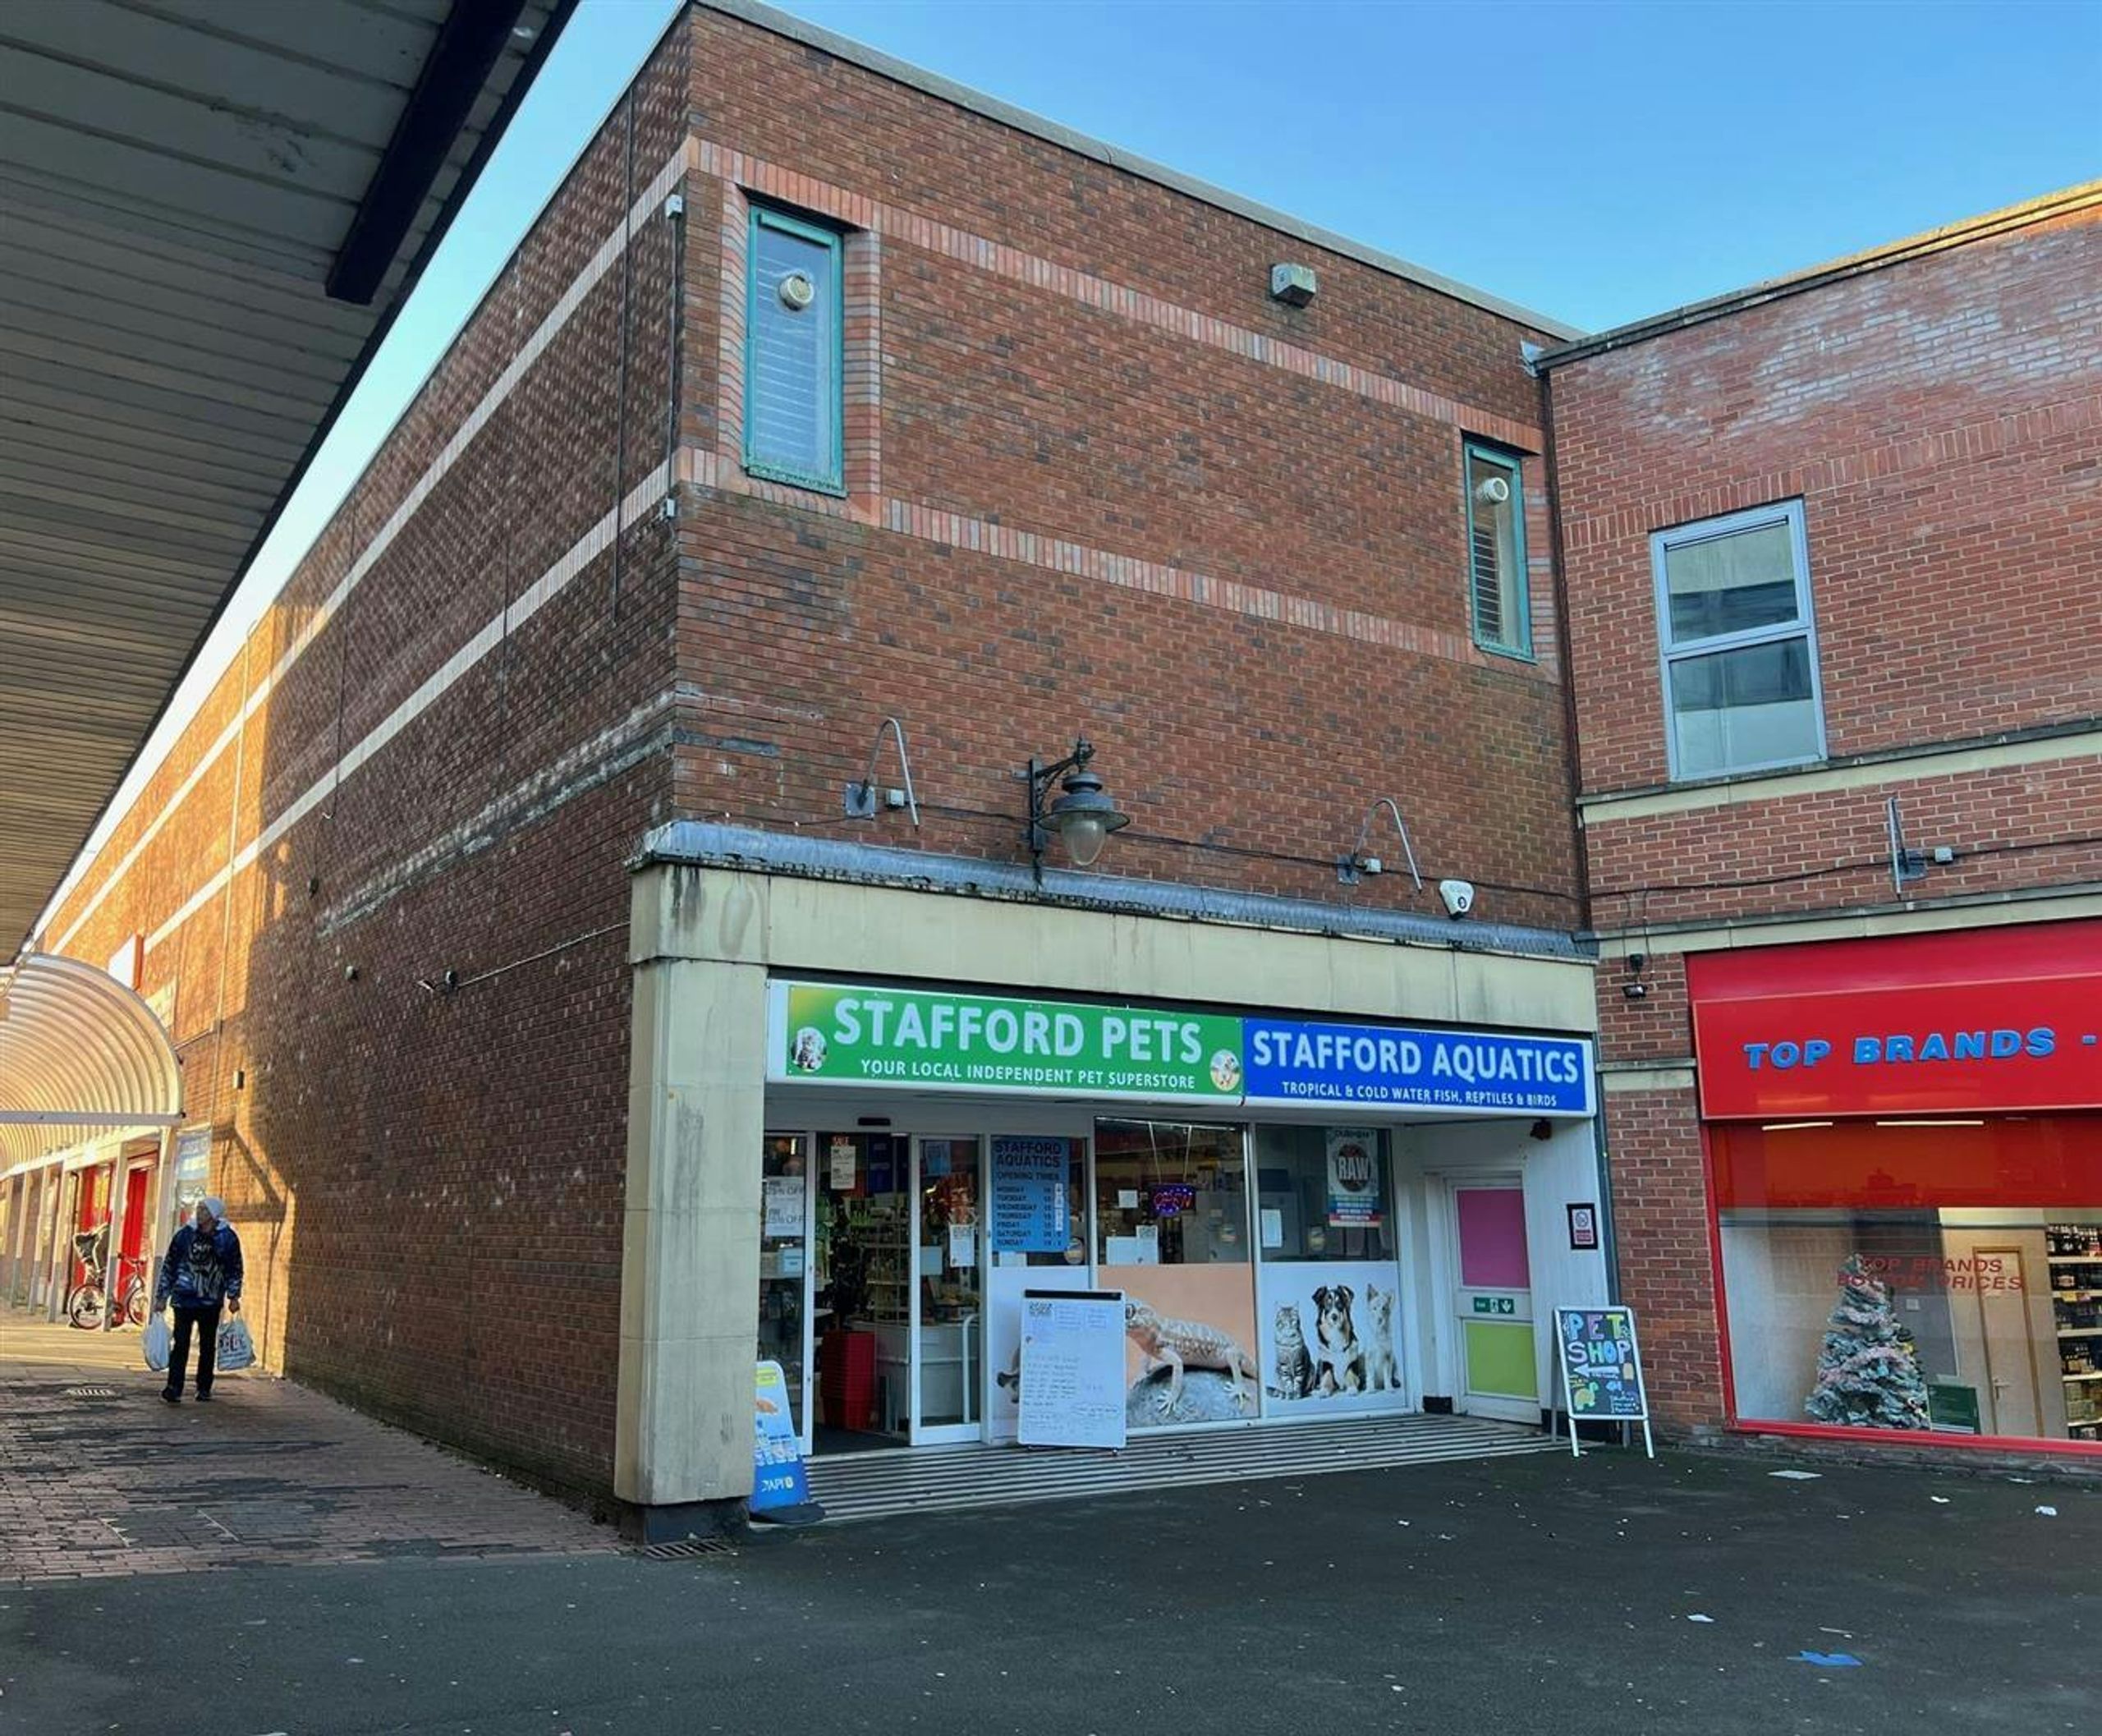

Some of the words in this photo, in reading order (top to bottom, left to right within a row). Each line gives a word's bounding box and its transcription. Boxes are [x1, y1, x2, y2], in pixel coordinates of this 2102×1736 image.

[833, 998, 1085, 1057] STAFFORD
[1101, 1016, 1203, 1064] PETS
[1253, 1030, 1422, 1075] STAFFORD
[1432, 1042, 1579, 1084] AQUATICS
[1743, 1039, 1832, 1069] TOP
[1852, 1027, 2056, 1065] BRANDS
[861, 1059, 906, 1076] YOUR
[911, 1061, 962, 1079] LOCAL
[966, 1065, 1073, 1083] INDEPENDENT
[1077, 1069, 1104, 1085] PET
[1108, 1071, 1196, 1090] SUPERSTORE
[1282, 1081, 1342, 1097] TROPICAL
[1345, 1086, 1354, 1097] &
[1357, 1085, 1388, 1100] COLD
[1392, 1086, 1431, 1102] WATER
[1466, 1091, 1514, 1106] REPTILES
[1526, 1093, 1558, 1108] BIRDS
[994, 1140, 1062, 1155] STAFFORD
[996, 1153, 1062, 1168] AQUATICS
[997, 1171, 1032, 1181] OPENING
[1338, 1155, 1370, 1181] RAW
[1913, 1256, 2003, 1273] BRANDS
[1939, 1275, 2023, 1291] PRICES
[1567, 1312, 1625, 1341] PET
[1567, 1339, 1632, 1364] SHOP
